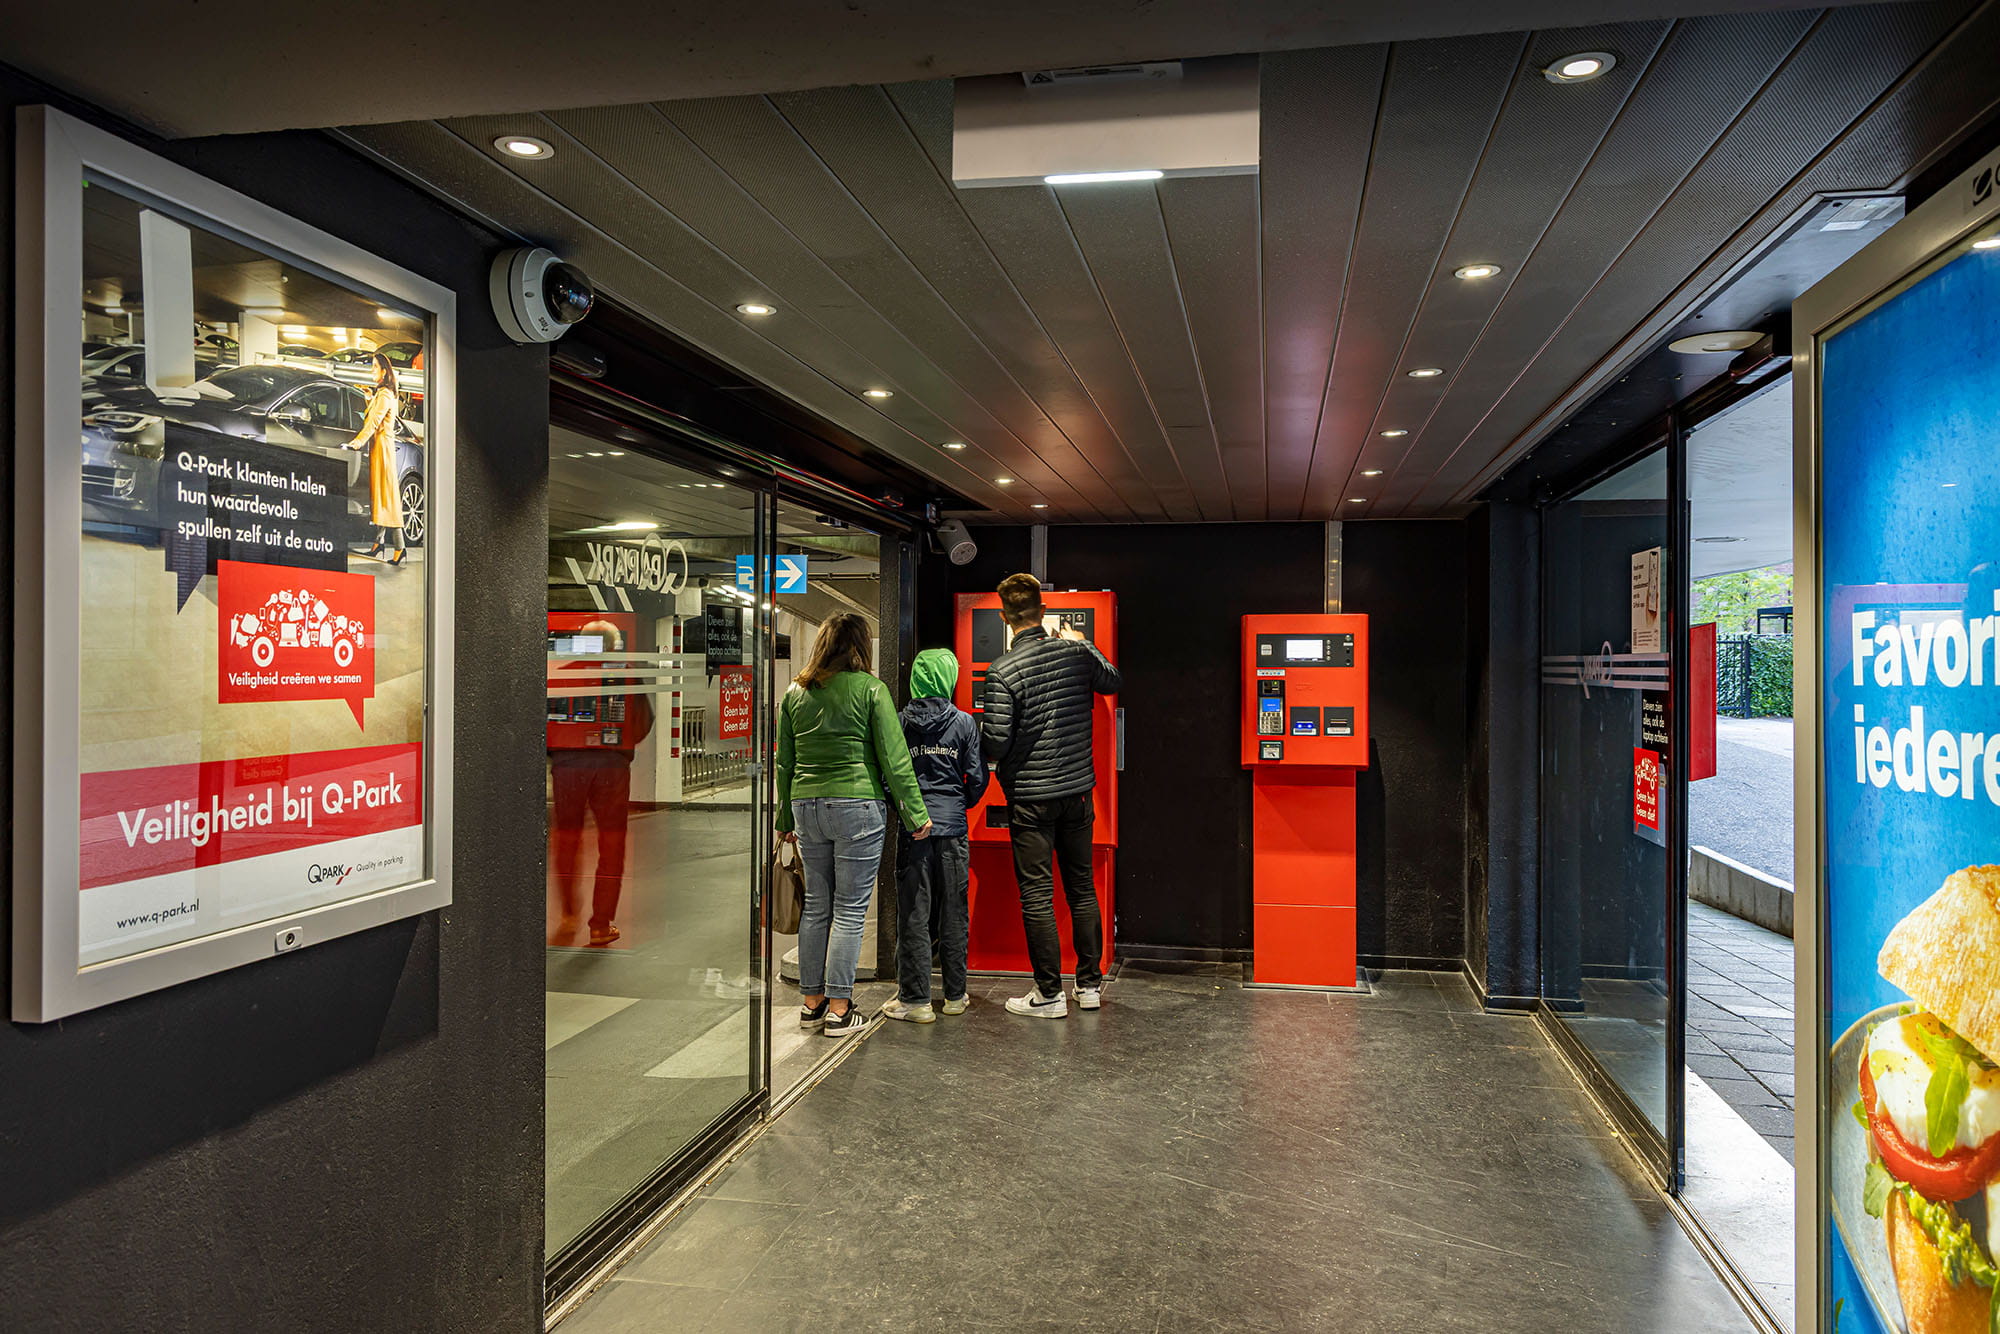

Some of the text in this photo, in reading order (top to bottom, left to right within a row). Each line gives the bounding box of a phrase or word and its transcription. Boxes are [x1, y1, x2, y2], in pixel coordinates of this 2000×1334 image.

[177, 451, 326, 497] Q-Park klanten halen
[177, 481, 298, 520] hun waardevolle
[177, 517, 333, 553] spullen zelf uit de auto
[228, 671, 362, 689] Veiligheid creëren we samen
[724, 705, 738, 717] Geen
[724, 720, 738, 732] Geen
[117, 772, 403, 848] Veiligheid bij Q-Park
[355, 861, 376, 872] Quality
[377, 859, 384, 867] in
[384, 855, 404, 868] parking
[116, 898, 200, 929] www.q-park.nl
